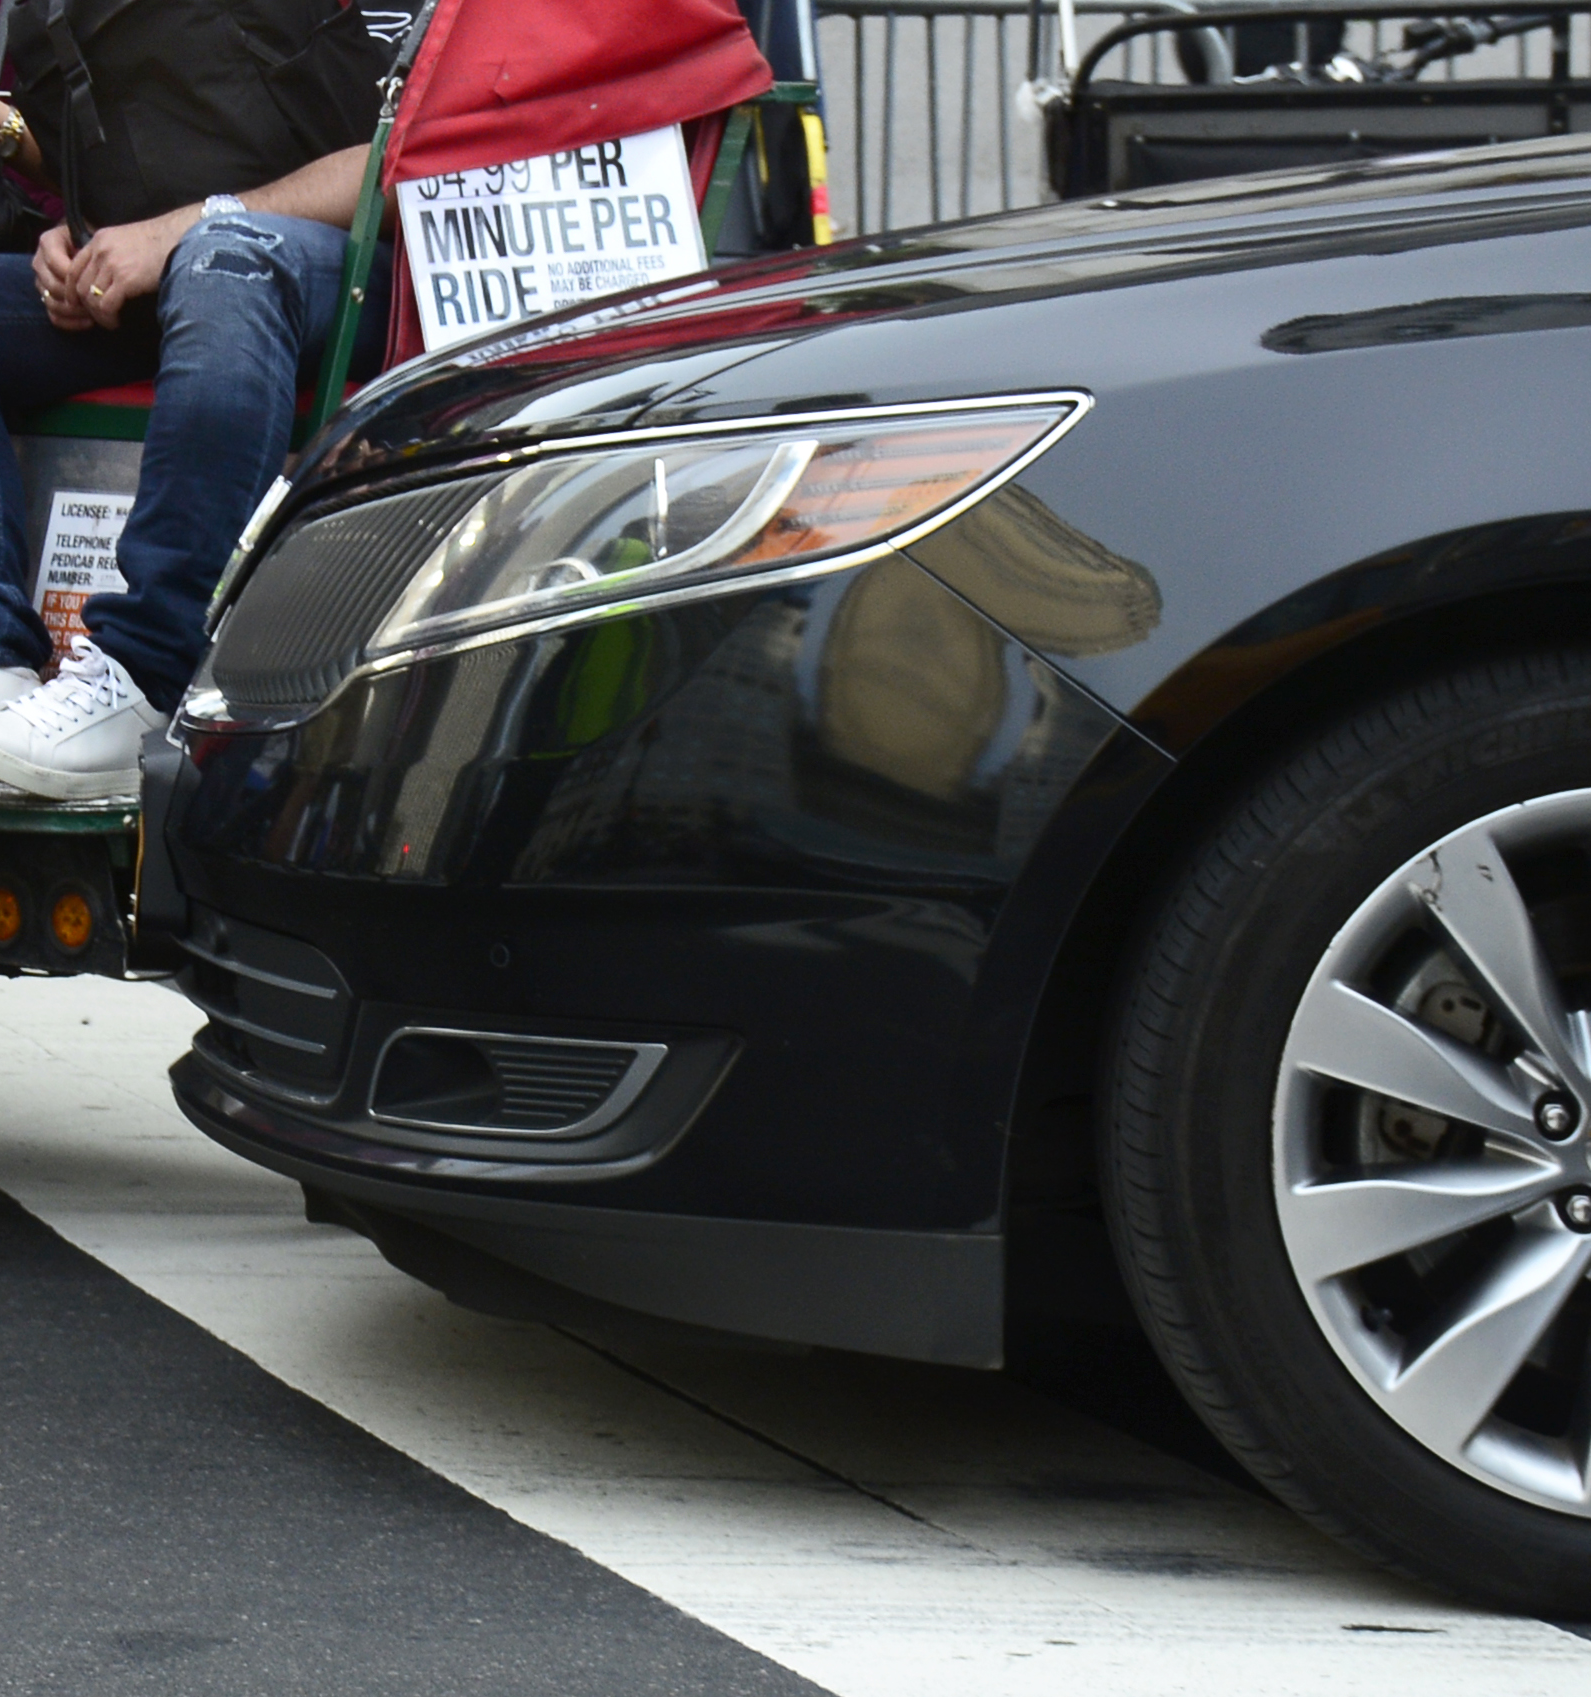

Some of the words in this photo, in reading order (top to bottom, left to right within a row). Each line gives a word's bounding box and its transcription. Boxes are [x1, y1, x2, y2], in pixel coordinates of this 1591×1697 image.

[548, 138, 629, 192] PER
[419, 199, 586, 264] MINUTE
[588, 193, 679, 252] PER
[547, 262, 564, 276] NO
[567, 257, 633, 275] ADDITIONAL
[636, 255, 666, 269] FEES
[550, 278, 575, 293] MAY
[578, 277, 593, 292] BE
[595, 272, 650, 290] CHARGED
[430, 264, 543, 327] RIDE
[56, 532, 113, 551] TELEPHONE
[50, 552, 96, 569] PEDICAB
[46, 591, 58, 608] IF
[59, 592, 82, 611] YOU
[44, 610, 68, 628] THIS
